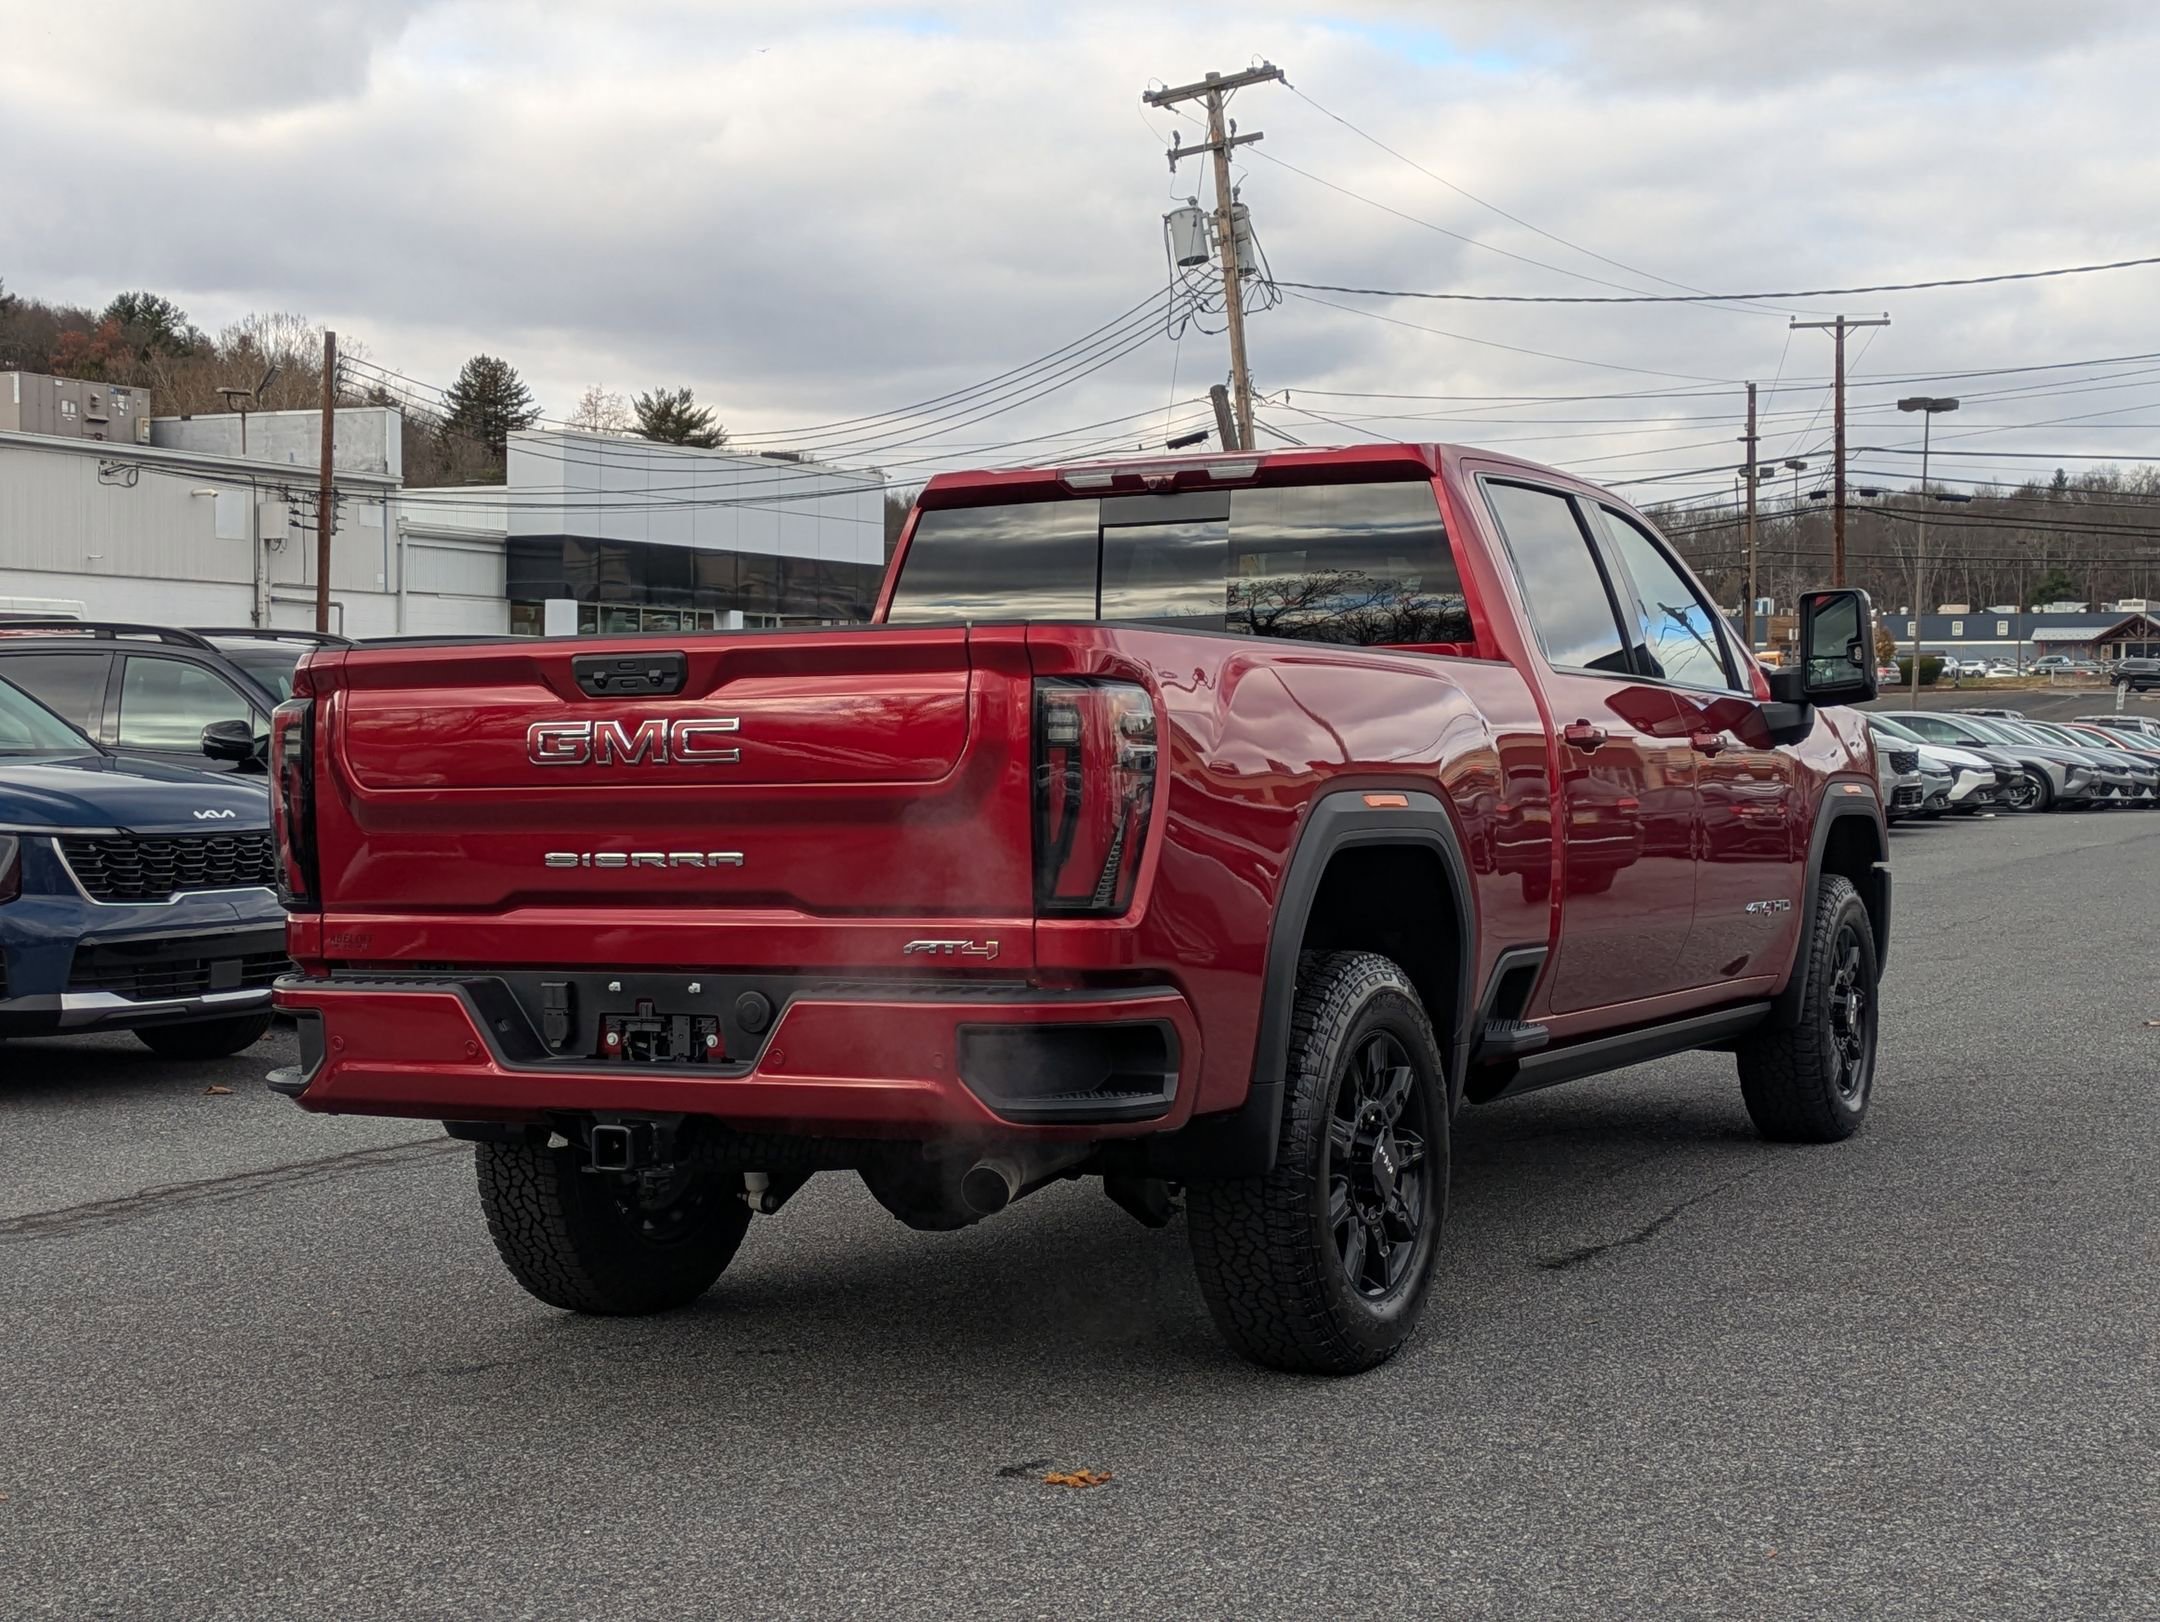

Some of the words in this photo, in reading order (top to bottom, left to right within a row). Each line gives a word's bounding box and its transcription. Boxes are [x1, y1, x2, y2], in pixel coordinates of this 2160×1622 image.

[527, 717, 740, 765] GMC
[544, 852, 744, 867] SIERRA
[903, 940, 999, 961] AT4
